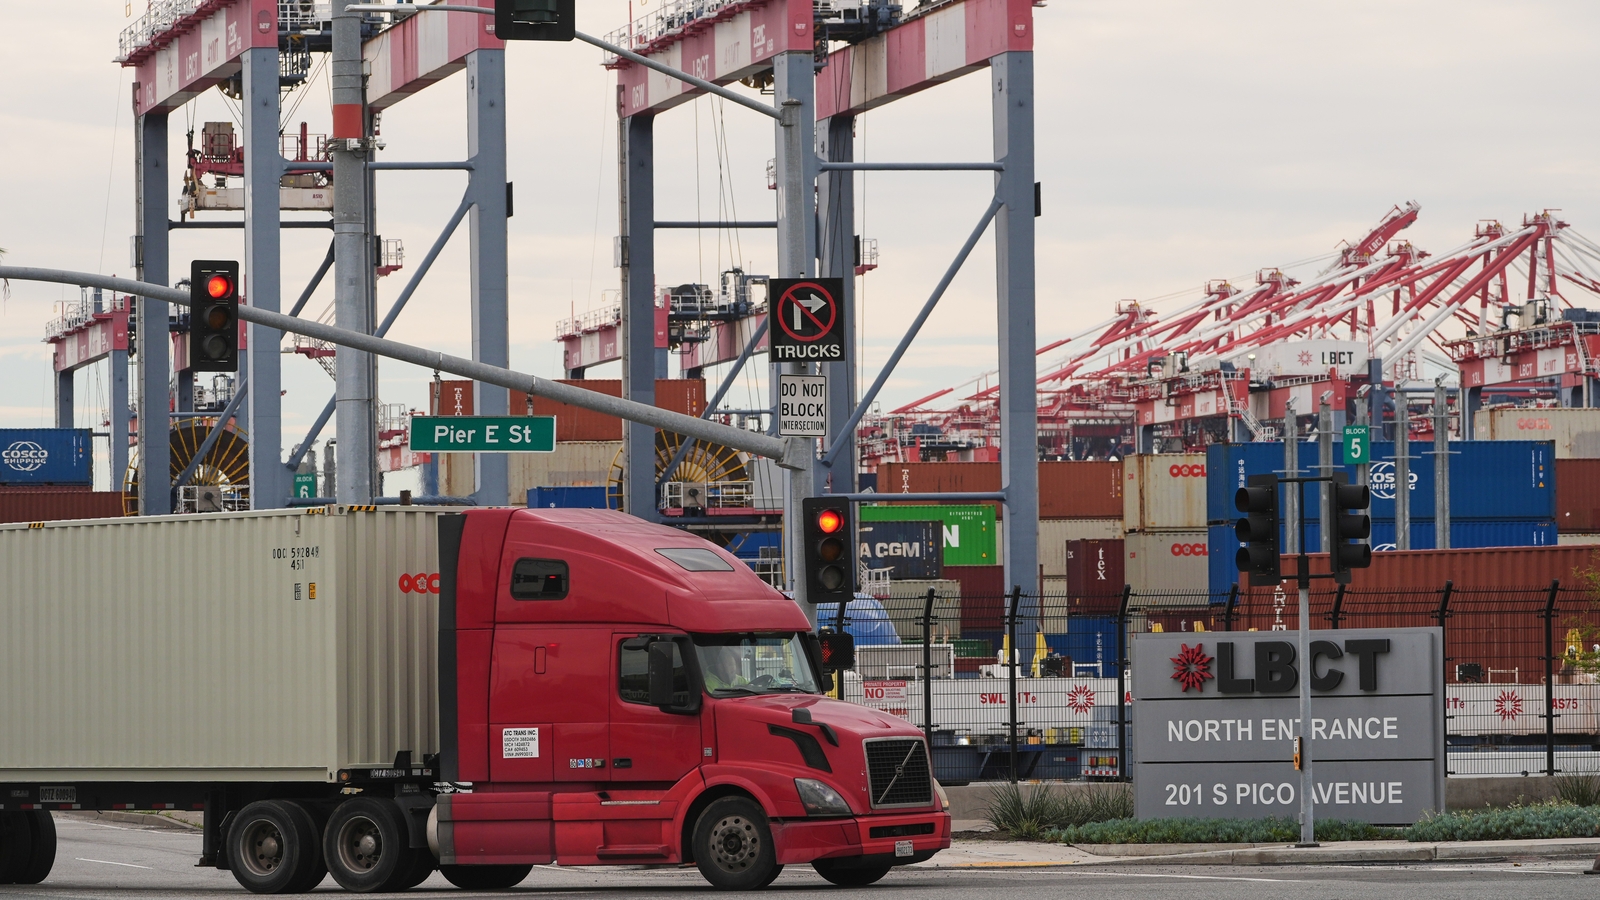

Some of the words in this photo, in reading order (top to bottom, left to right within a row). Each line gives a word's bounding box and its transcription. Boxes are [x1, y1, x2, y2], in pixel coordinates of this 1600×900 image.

[185, 52, 198, 80] LBCT
[1368, 236, 1384, 252] LBCT
[775, 344, 841, 358] TRUCKS
[1321, 352, 1354, 365] LBCT
[1519, 363, 1533, 377] LBCT
[782, 383, 797, 397] DO
[803, 384, 824, 397] NOT
[782, 403, 824, 417] BLOCK
[781, 420, 825, 431] INTERSECTION
[1517, 418, 1552, 430] OOCL
[434, 425, 476, 443] Pier
[486, 425, 499, 443] E
[508, 424, 531, 443] St
[2, 450, 48, 458] COSCO
[1351, 438, 1361, 458] 5
[1169, 465, 1207, 477] OOCL
[1370, 473, 1418, 483] OSO
[875, 543, 920, 558] CGM
[1171, 543, 1208, 556] OOCL
[1097, 547, 1106, 580] tex
[398, 573, 440, 594] OOC
[1217, 639, 1391, 692] LBCT
[865, 688, 884, 698] NO
[980, 693, 1006, 703] SWL
[1551, 698, 1578, 709] AS75
[1168, 719, 1252, 741] NORTH
[1262, 717, 1398, 740] ENRANCE
[1165, 783, 1202, 805] 201
[1212, 783, 1228, 804] S
[1236, 783, 1295, 804] PICO
